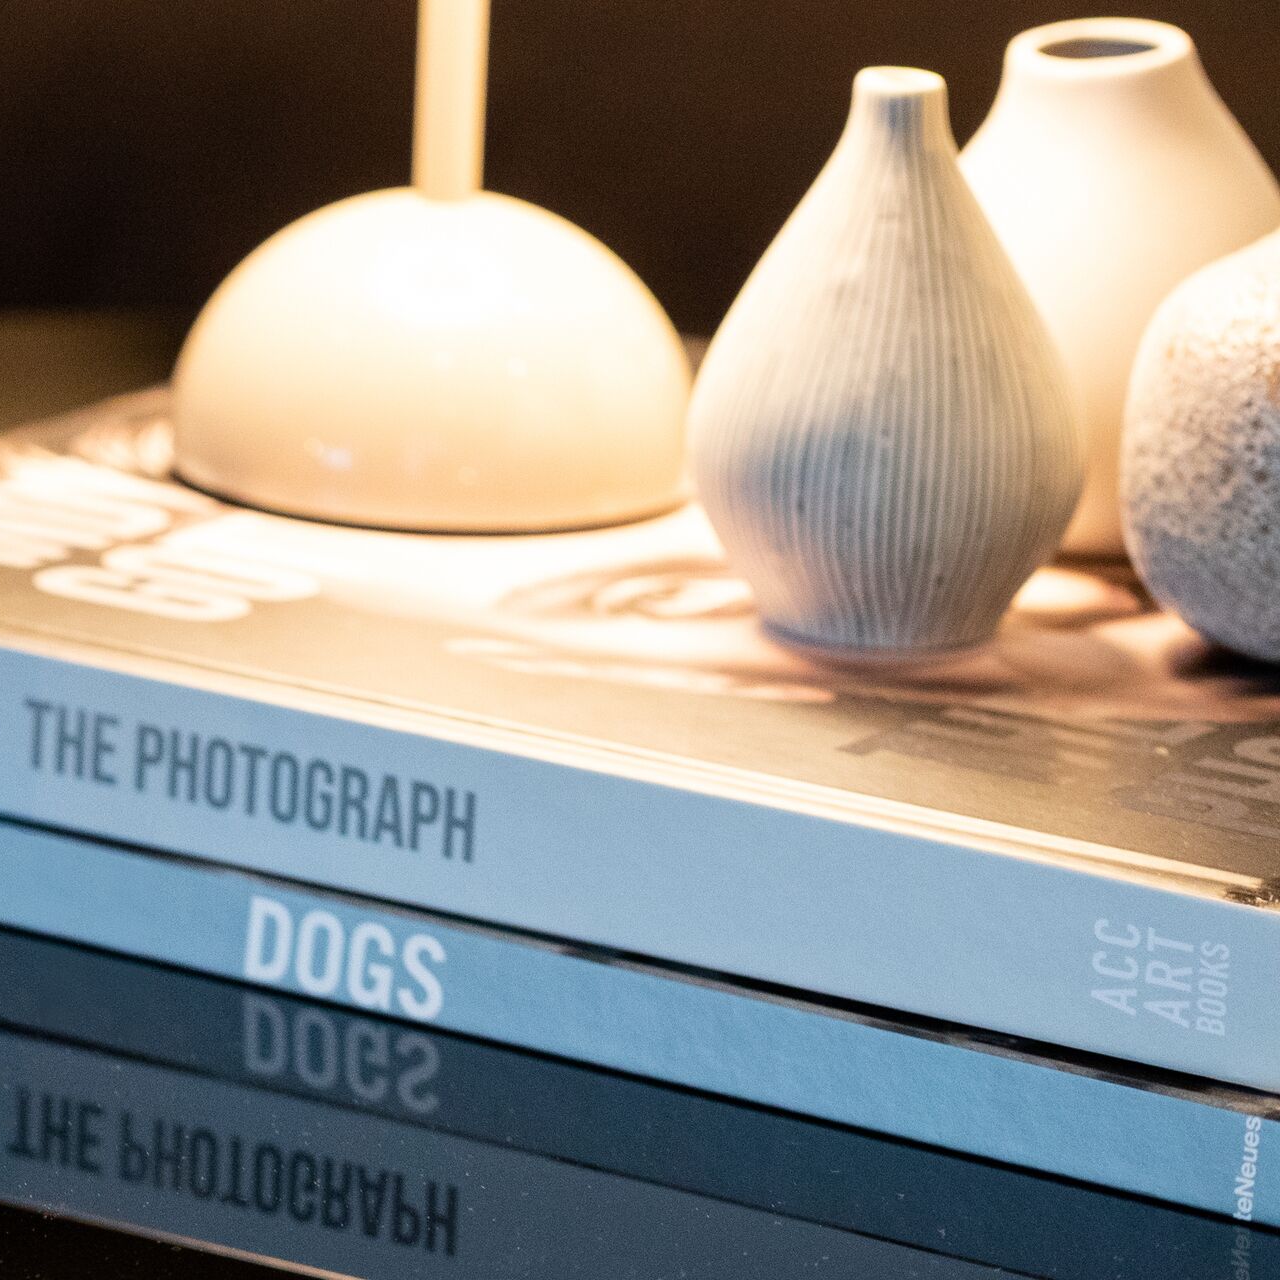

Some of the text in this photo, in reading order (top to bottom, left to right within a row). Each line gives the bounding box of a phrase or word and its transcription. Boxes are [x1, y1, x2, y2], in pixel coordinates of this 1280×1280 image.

[24, 697, 477, 864] THE PHOTOGRAPH
[243, 895, 447, 1020] DOGS
[1090, 918, 1141, 1018] ACC
[1142, 926, 1195, 1030] ART
[1196, 940, 1231, 1037] BOOKS
[1232, 1115, 1262, 1221] teNeues
